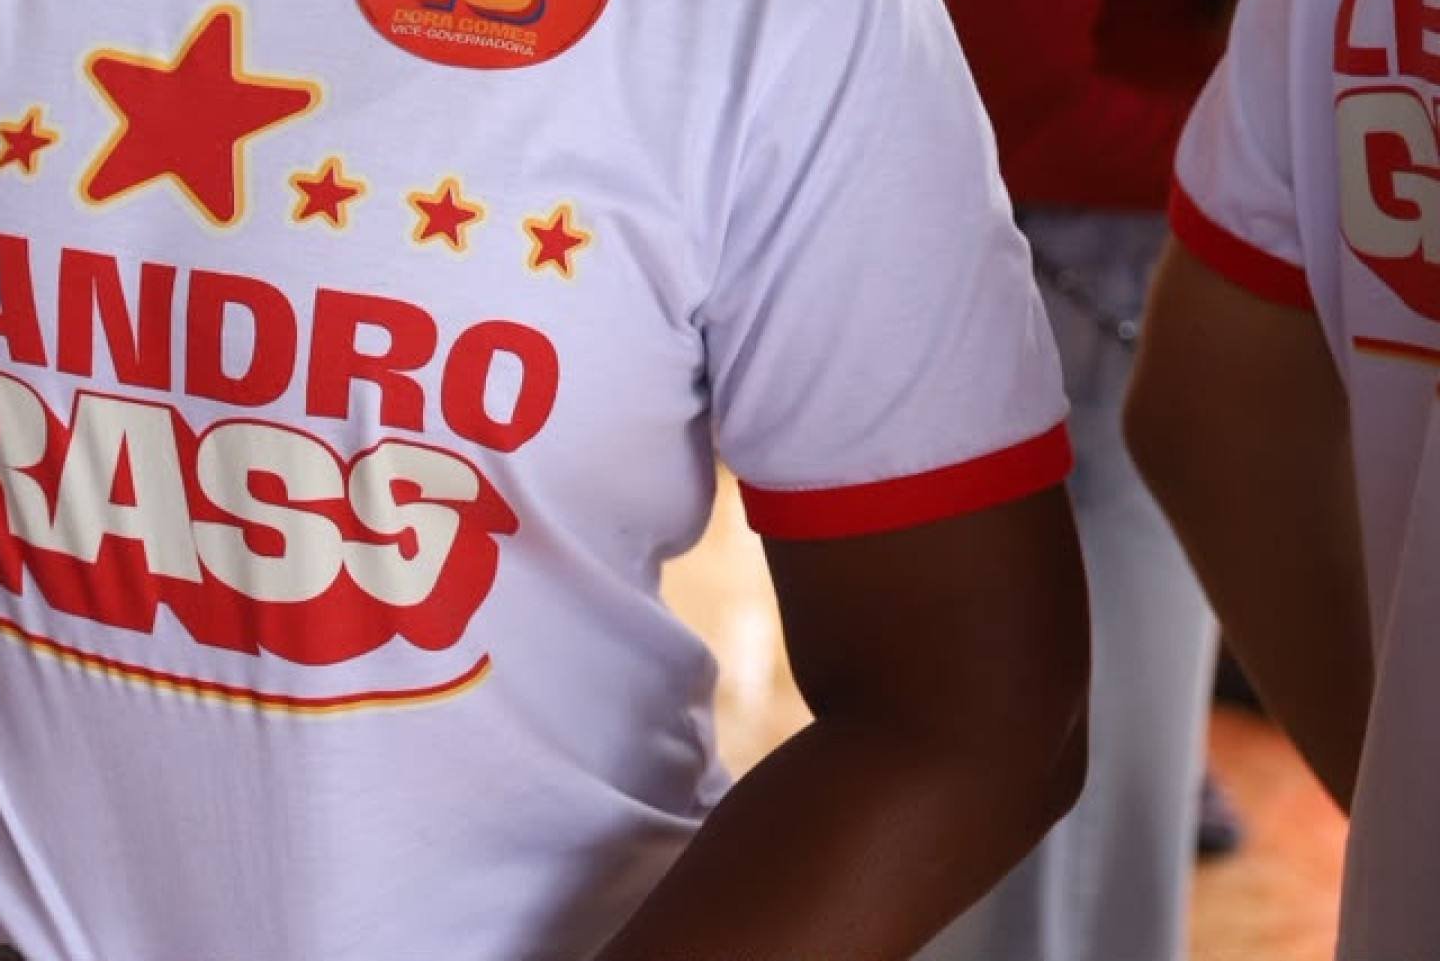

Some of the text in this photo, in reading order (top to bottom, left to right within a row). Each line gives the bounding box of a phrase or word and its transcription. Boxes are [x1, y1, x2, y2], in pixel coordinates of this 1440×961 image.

[390, 22, 535, 57] VICE-GOVERNADORA
[392, 8, 538, 46] DORA GOMES
[1334, 85, 1440, 260] G
